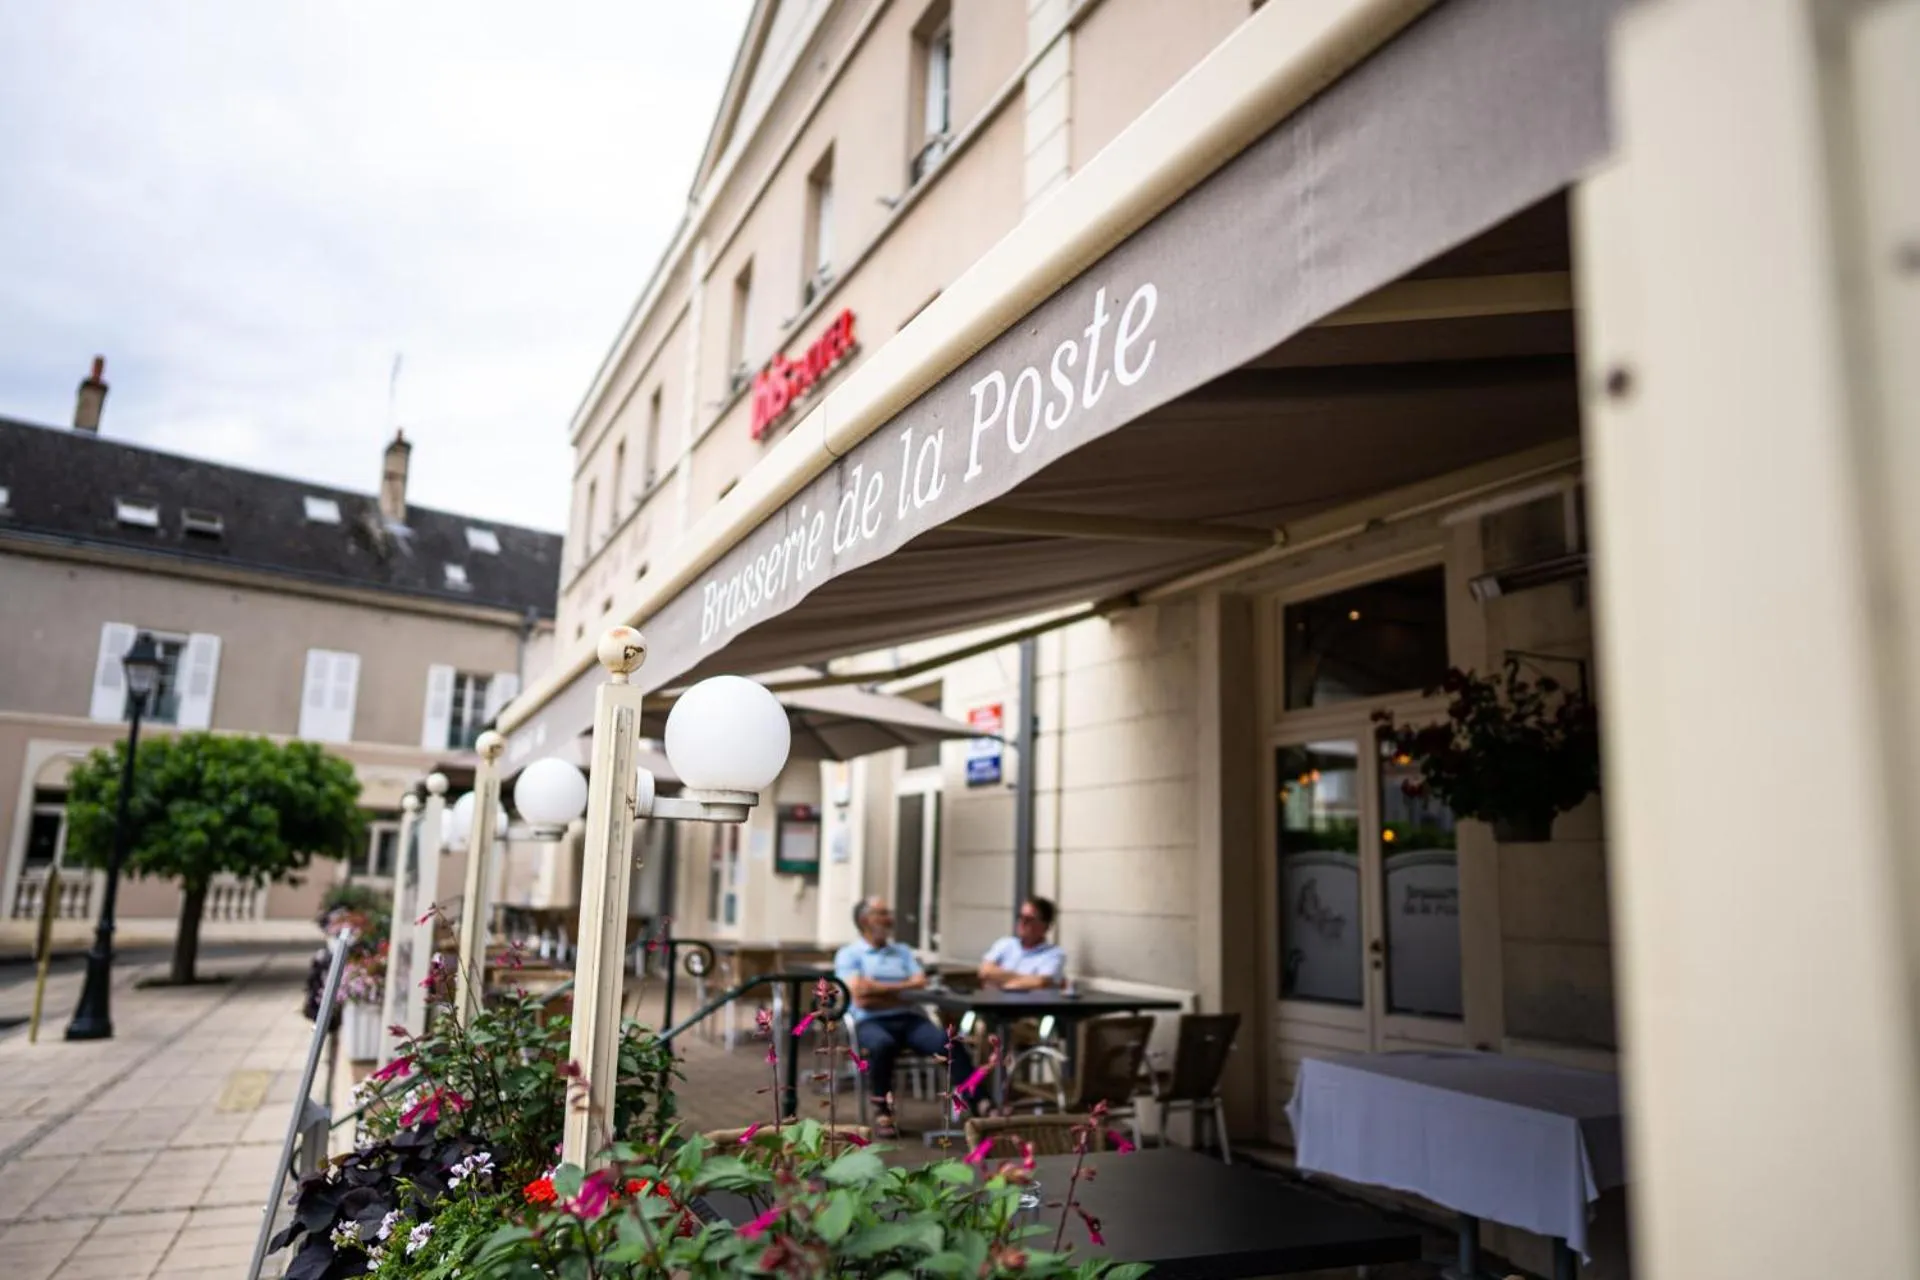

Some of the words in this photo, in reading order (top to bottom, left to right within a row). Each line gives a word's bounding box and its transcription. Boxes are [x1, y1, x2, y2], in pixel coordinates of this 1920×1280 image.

[699, 504, 825, 645] Brasserie
[832, 466, 885, 556] de
[897, 427, 947, 521] la
[963, 281, 1158, 484] Poste
